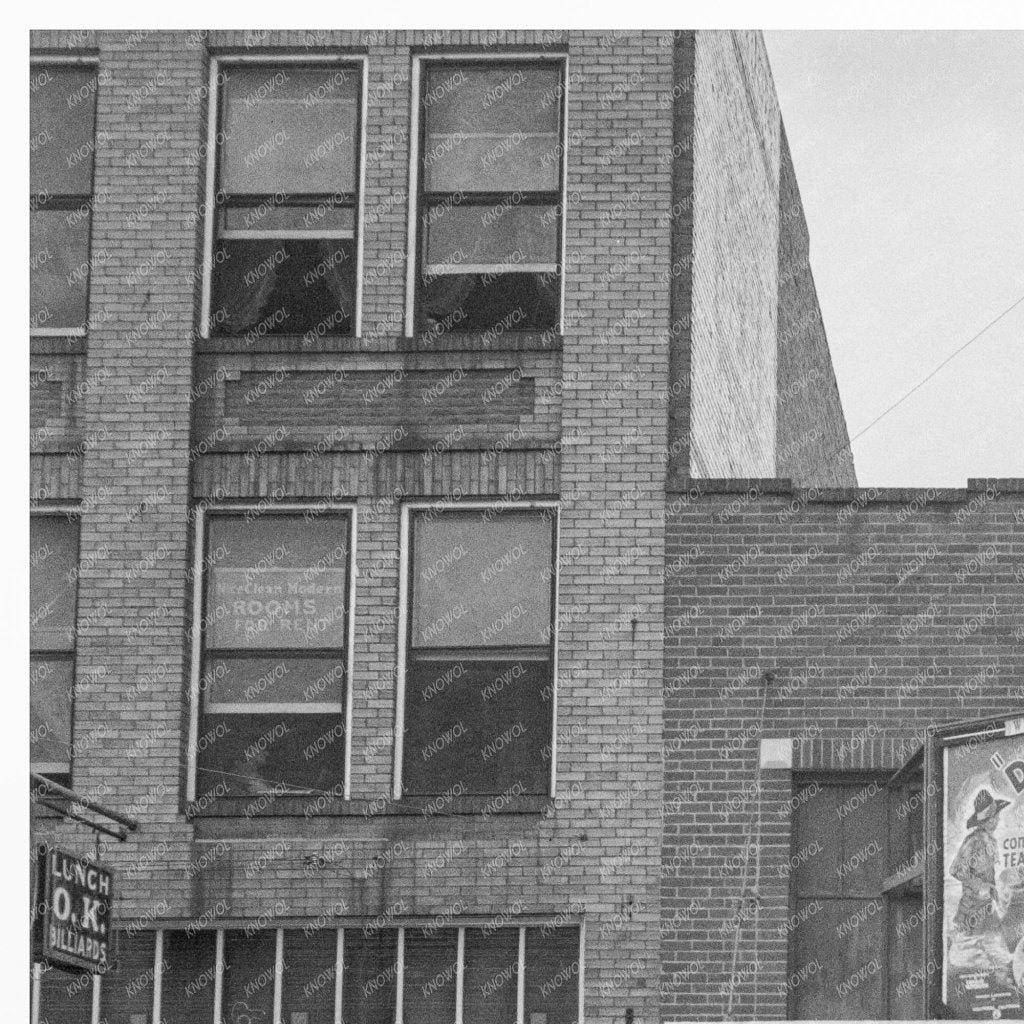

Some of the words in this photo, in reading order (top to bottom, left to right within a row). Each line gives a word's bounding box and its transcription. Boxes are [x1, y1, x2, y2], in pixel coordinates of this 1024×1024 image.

[233, 599, 317, 616] ROOMS
[52, 854, 109, 896] LUNCH
[53, 886, 106, 935] O.K.
[49, 925, 108, 962] BILLIARDS
